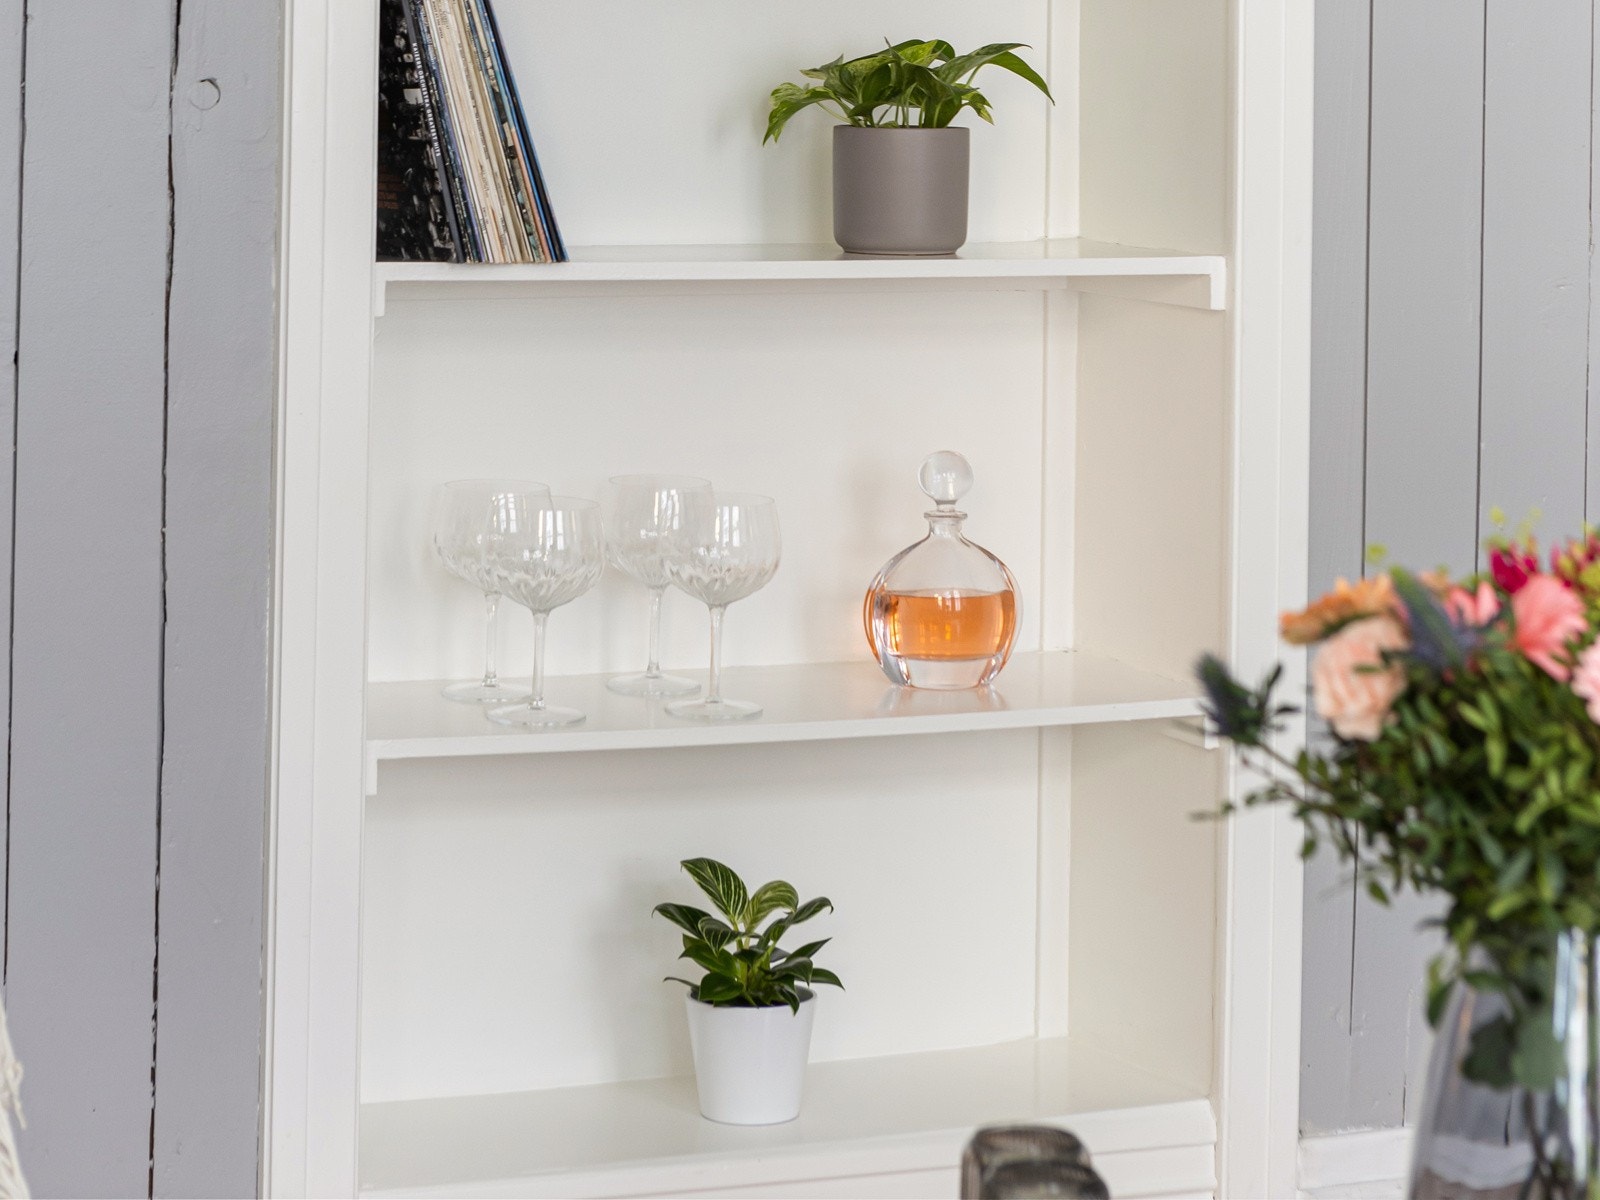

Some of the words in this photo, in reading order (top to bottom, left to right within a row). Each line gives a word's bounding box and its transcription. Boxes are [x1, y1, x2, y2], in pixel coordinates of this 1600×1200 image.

[412, 42, 423, 70] KAIZERS
[419, 70, 430, 108] ORCHESTRA
[426, 108, 438, 142] GREATEST
[433, 141, 441, 157] HITS
